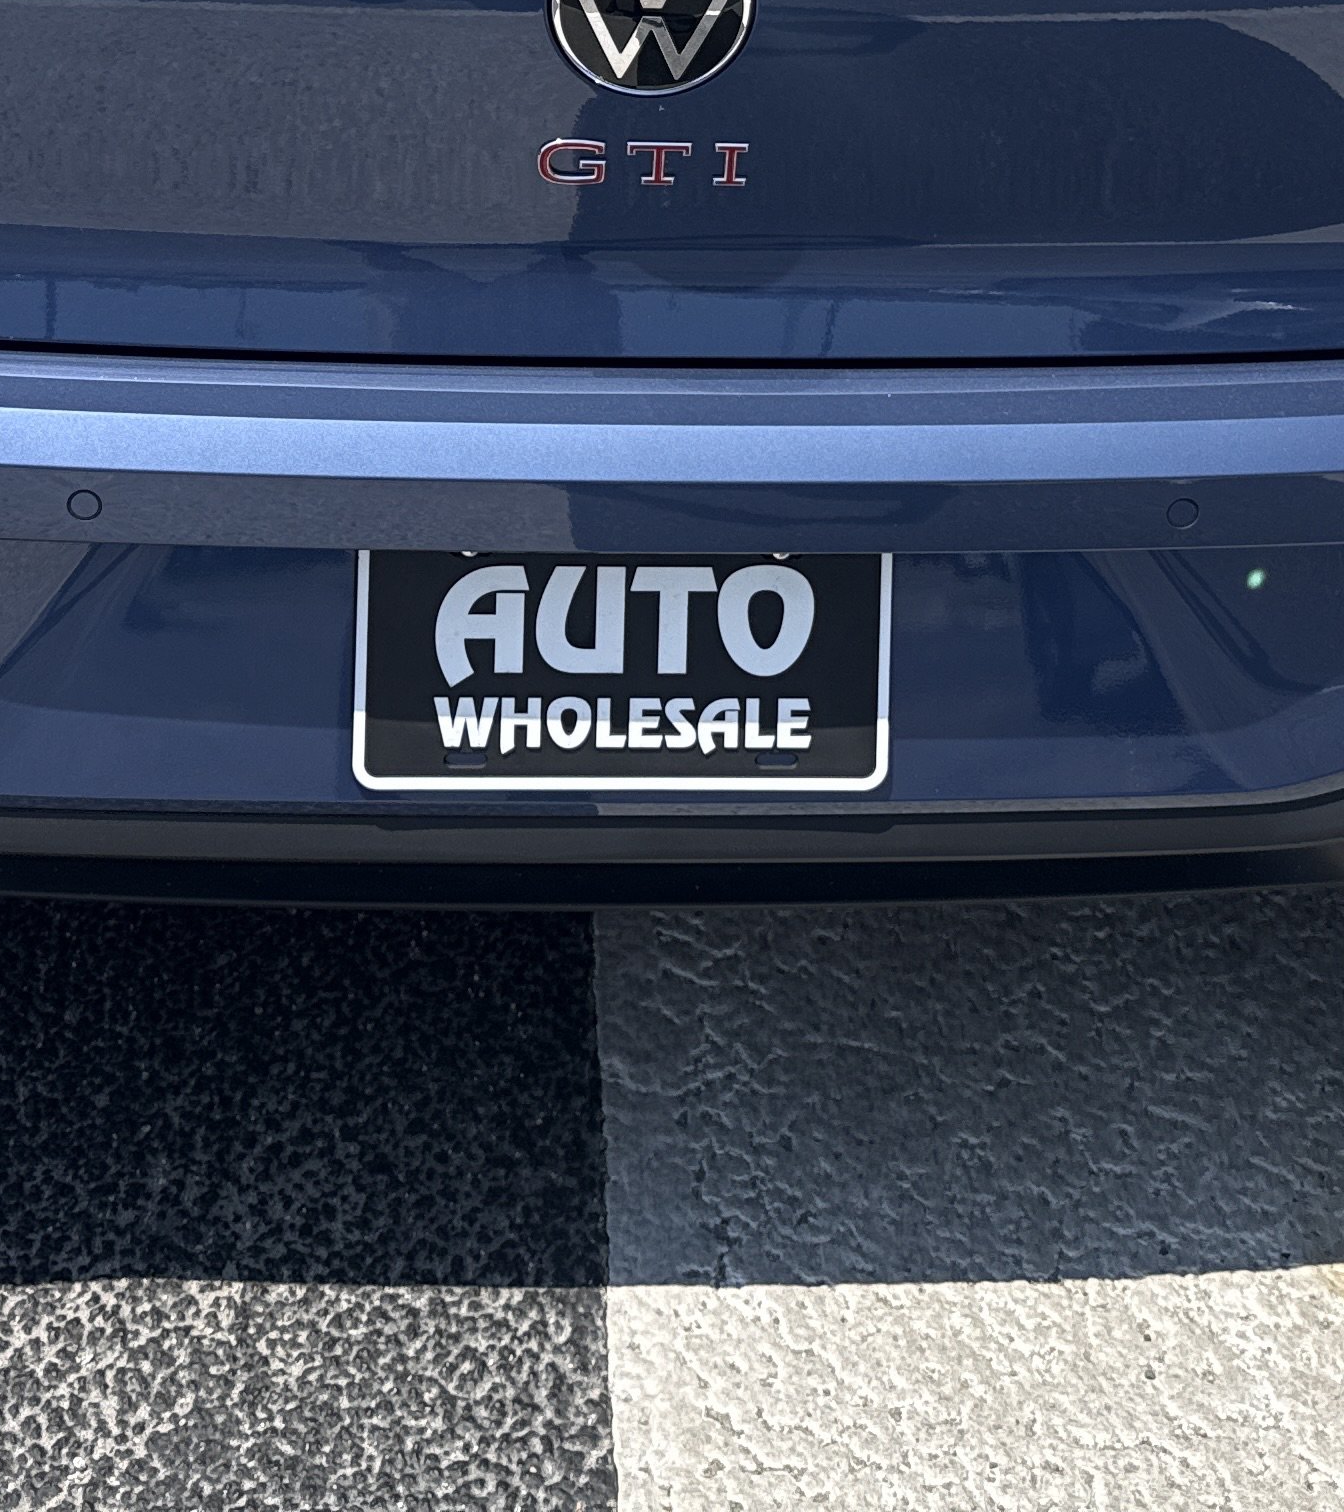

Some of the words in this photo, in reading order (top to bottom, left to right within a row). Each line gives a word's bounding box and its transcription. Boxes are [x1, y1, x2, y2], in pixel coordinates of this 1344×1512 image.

[537, 138, 750, 186] GTI
[434, 564, 815, 688] AUTO
[433, 696, 812, 756] WHOLESALE
